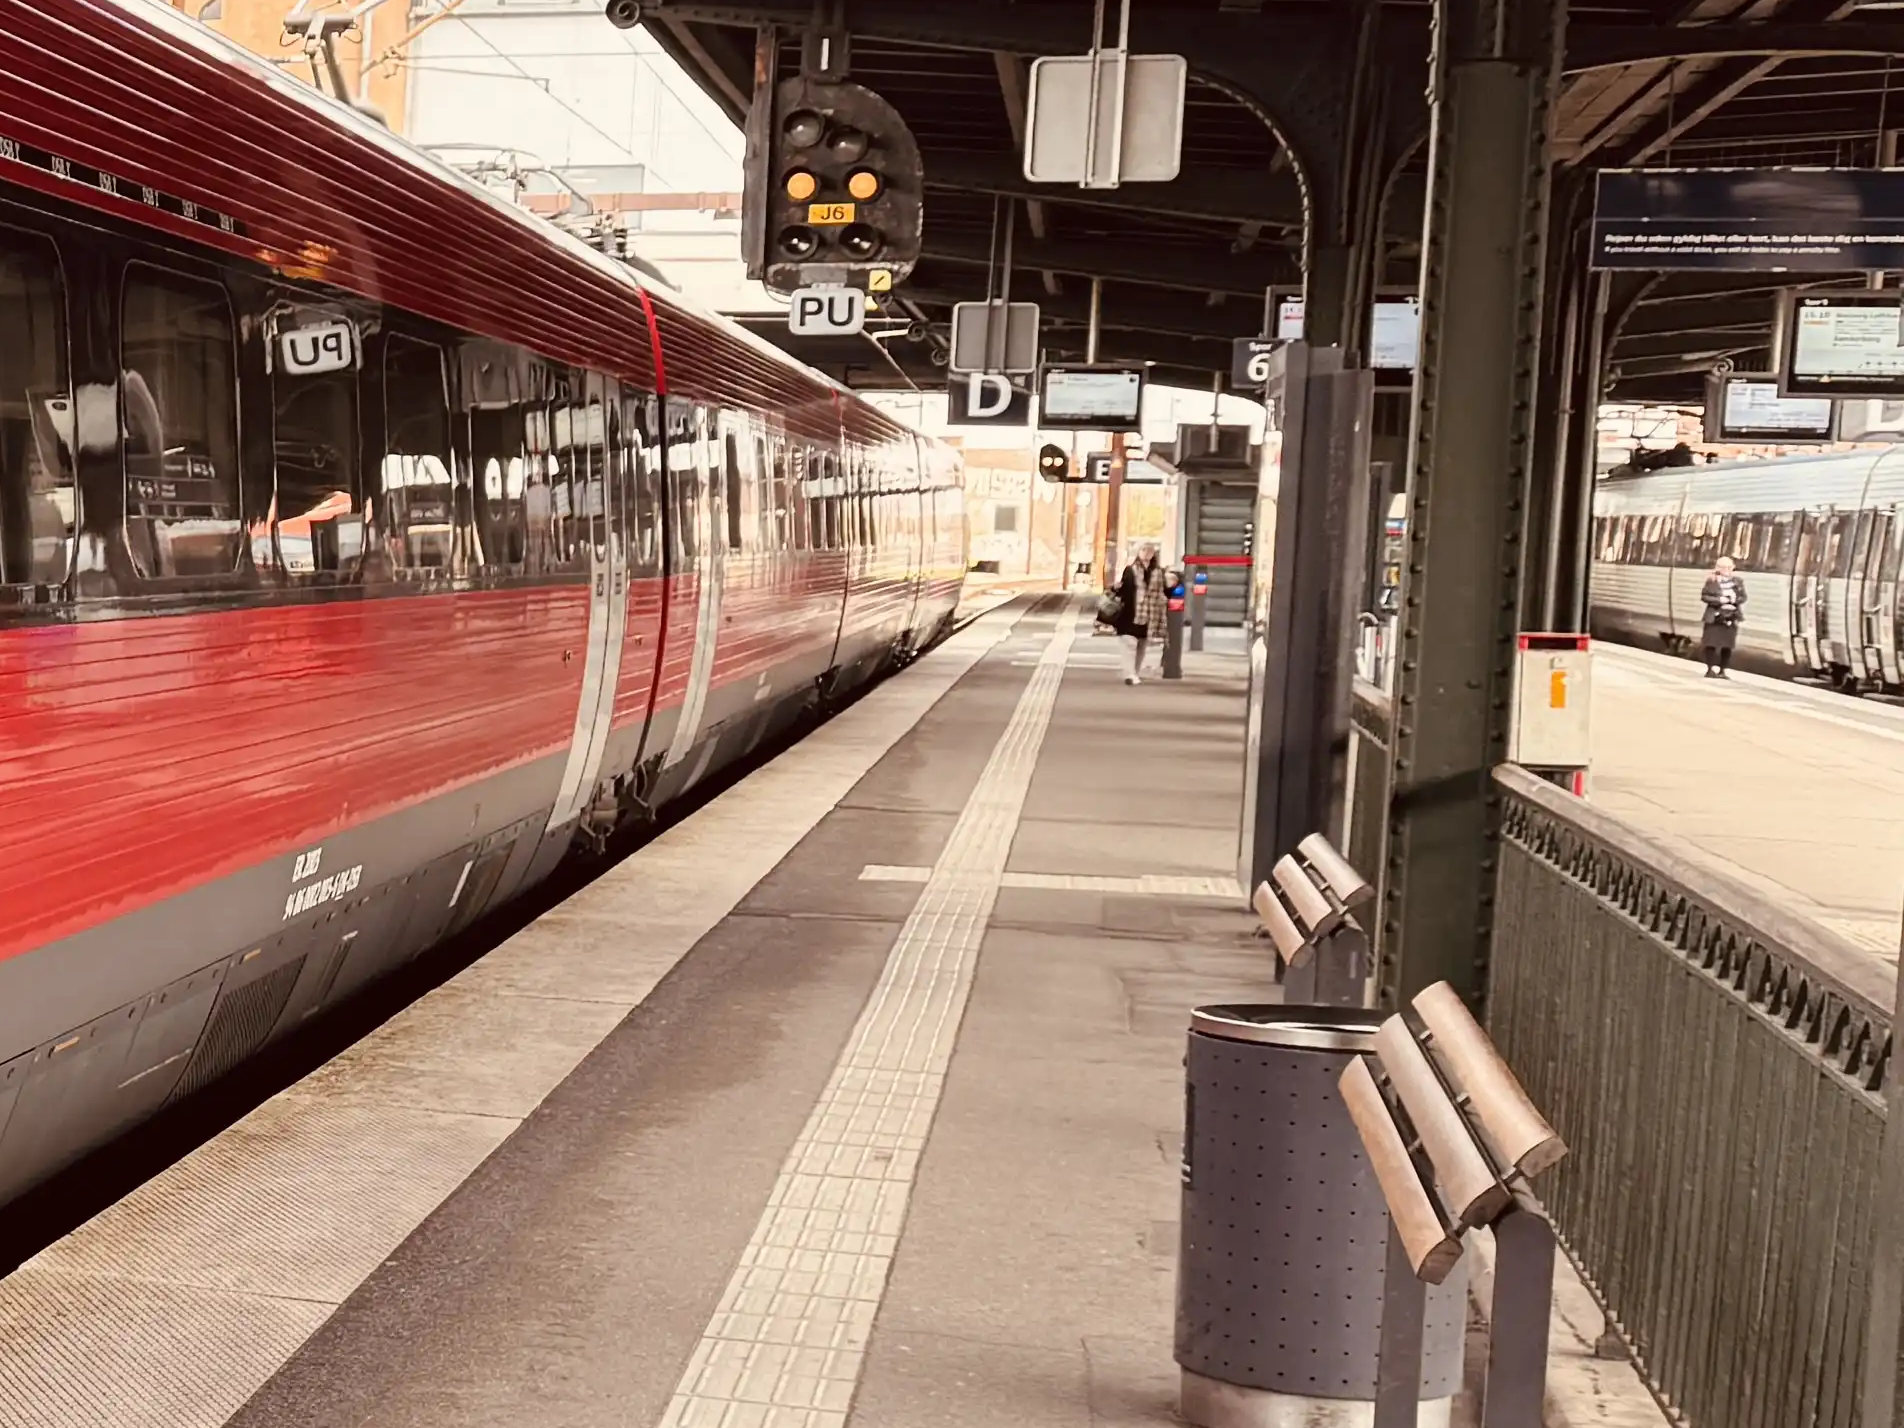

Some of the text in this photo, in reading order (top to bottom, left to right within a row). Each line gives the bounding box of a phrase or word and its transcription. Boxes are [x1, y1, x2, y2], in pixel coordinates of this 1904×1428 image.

[820, 206, 845, 220] J6
[799, 296, 854, 327] PU
[1247, 353, 1271, 382] 6
[968, 373, 1012, 417] D
